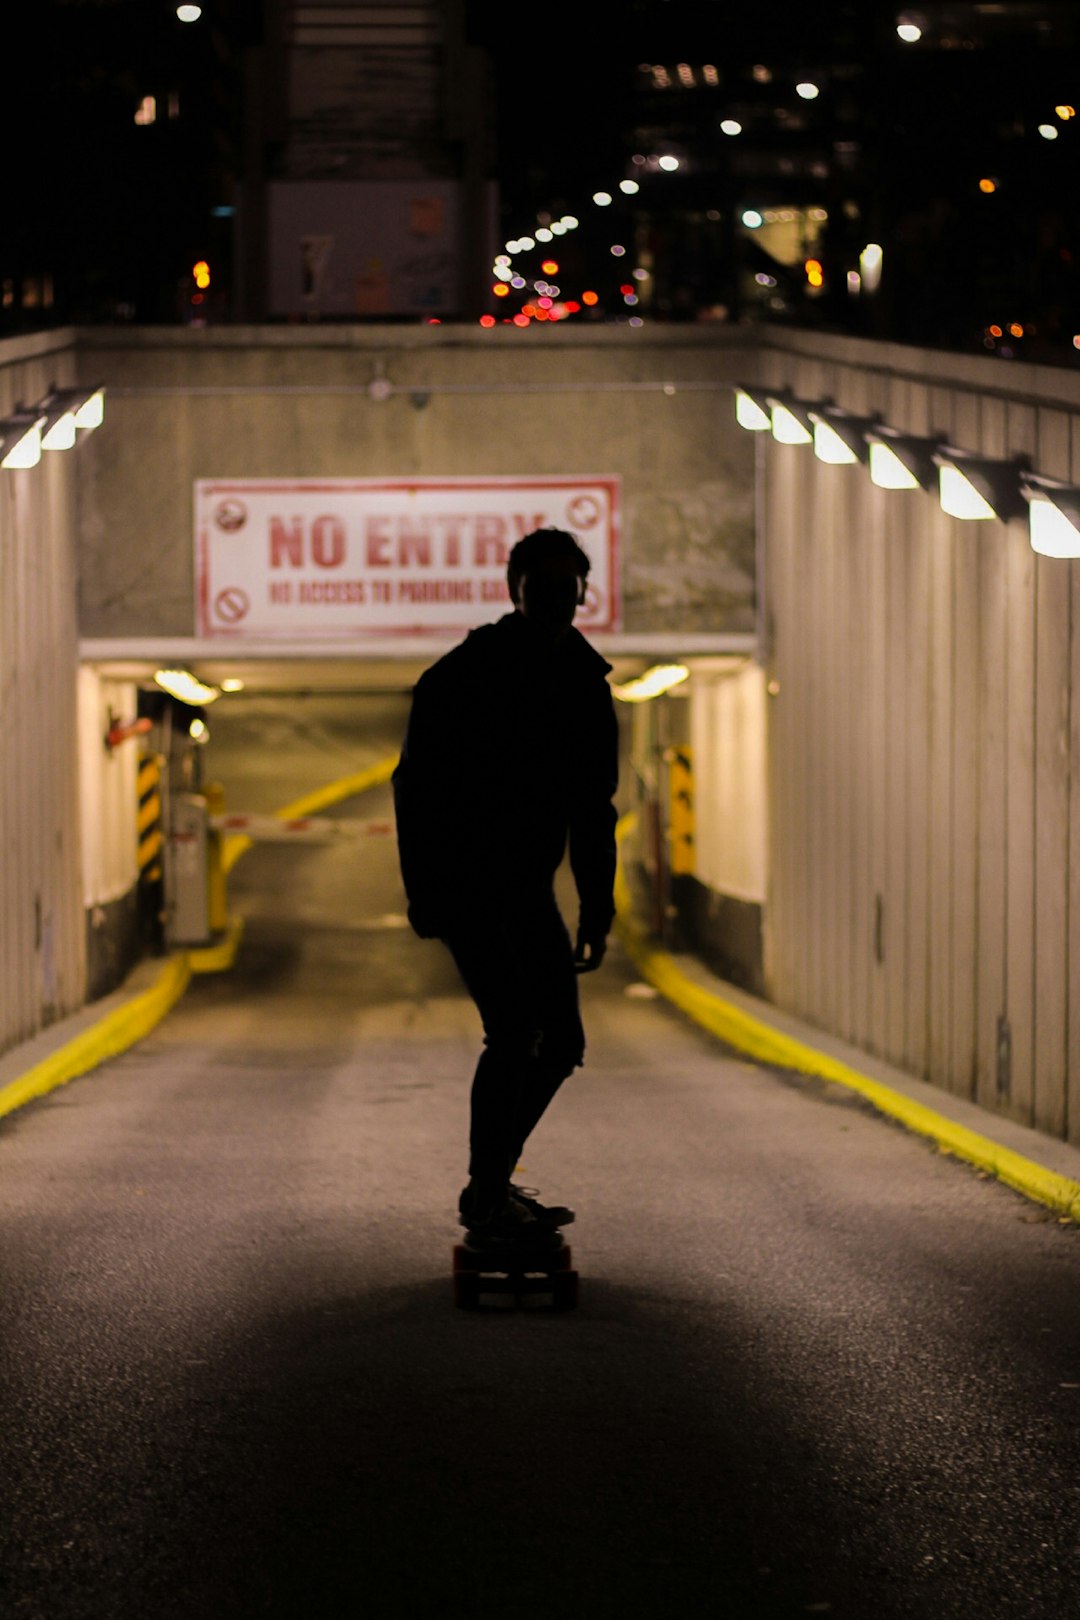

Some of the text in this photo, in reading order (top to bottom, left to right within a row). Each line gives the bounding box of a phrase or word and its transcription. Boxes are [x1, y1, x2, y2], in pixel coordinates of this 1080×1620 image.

[268, 514, 346, 569] NO
[299, 580, 364, 605] ACCESS
[399, 580, 472, 604] PARKING
